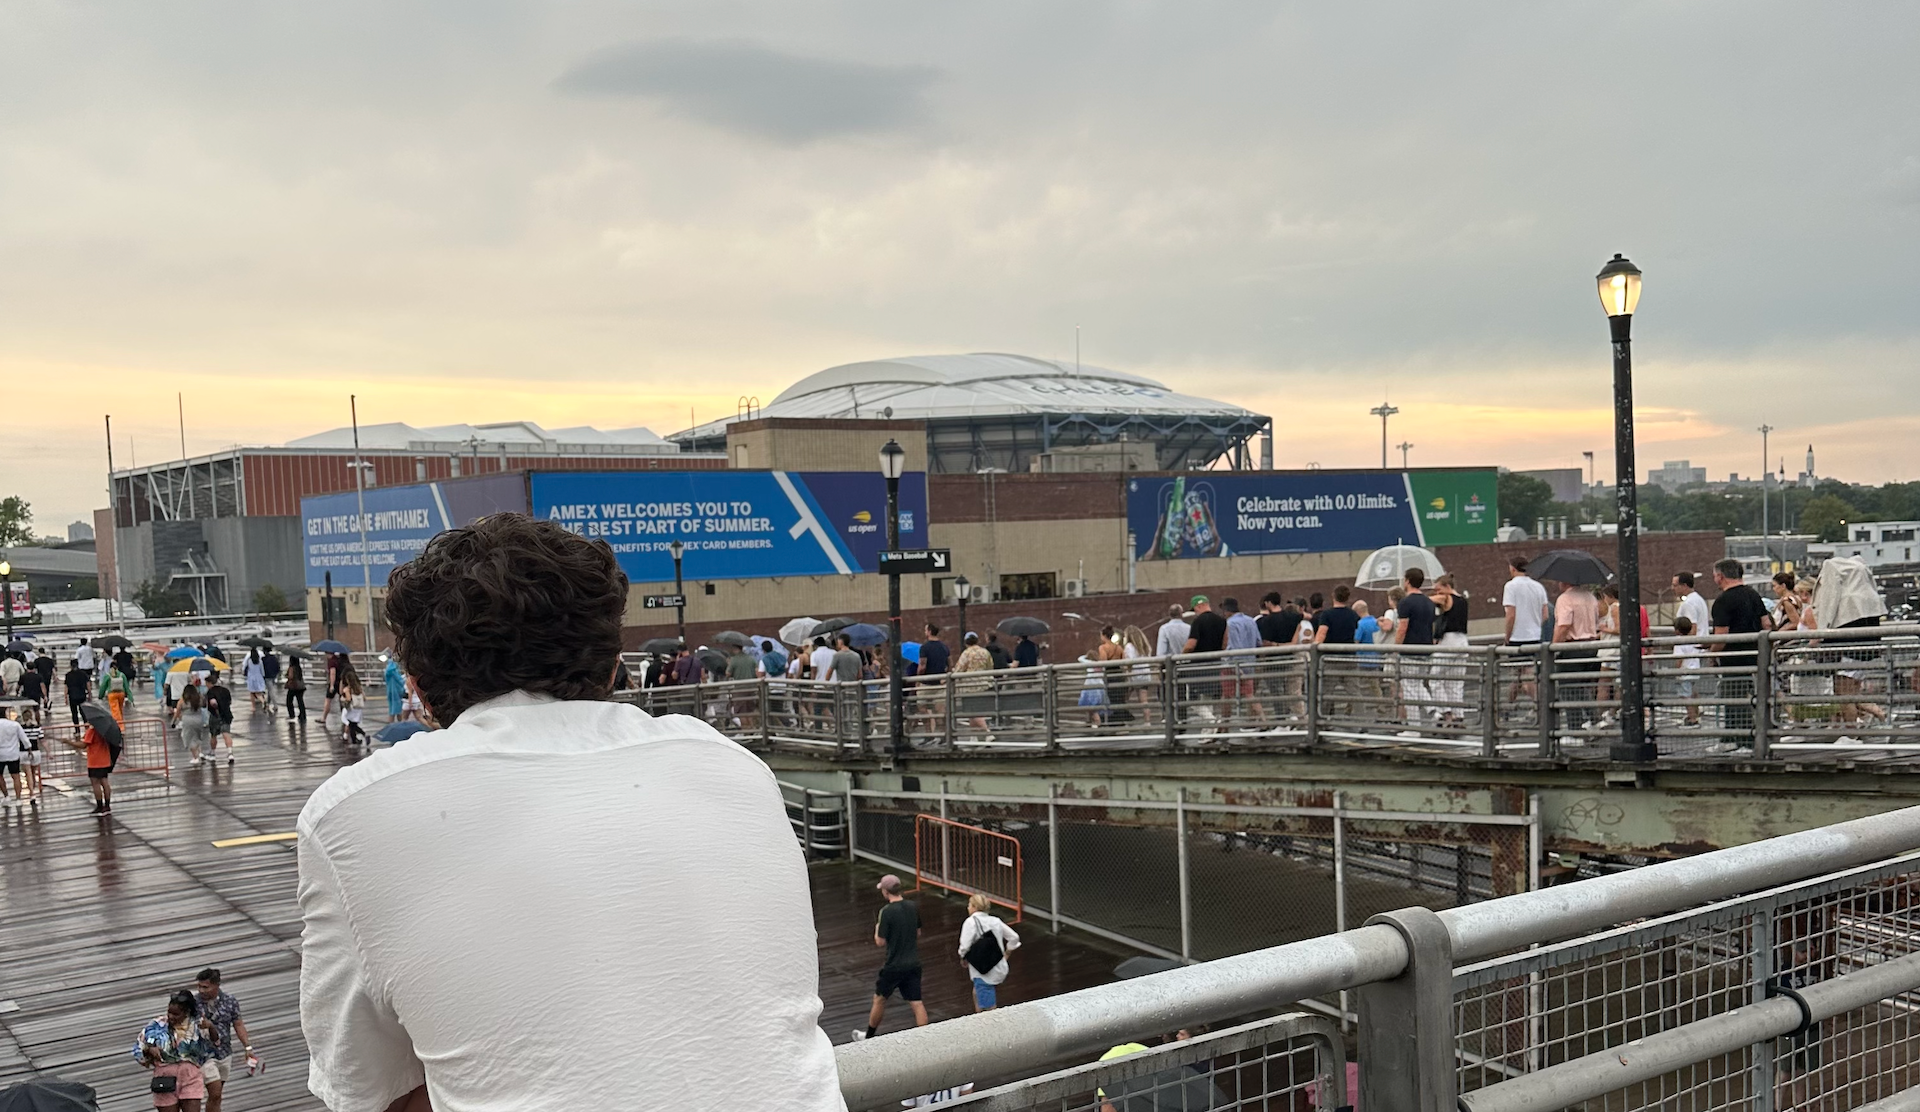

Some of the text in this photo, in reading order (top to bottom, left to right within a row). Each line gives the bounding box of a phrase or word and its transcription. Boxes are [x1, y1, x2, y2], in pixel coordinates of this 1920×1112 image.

[550, 501, 752, 520] AMEX WELCOMES YOU TO
[1237, 493, 1397, 513] Celebrate with 0.0 limits.
[307, 518, 322, 536] GET
[323, 517, 332, 535] IN
[332, 515, 349, 534] THE
[374, 508, 430, 531] #WITHAMEX
[561, 517, 775, 537] HE BEST PART OF SUMMER.
[848, 524, 877, 534] us open
[1237, 514, 1323, 533] Now you can.
[610, 542, 652, 553] ENEFITS
[653, 541, 672, 551] FOR
[702, 540, 727, 550] CARD
[728, 539, 774, 549] MEMBERS.
[903, 552, 928, 560] Baseball
